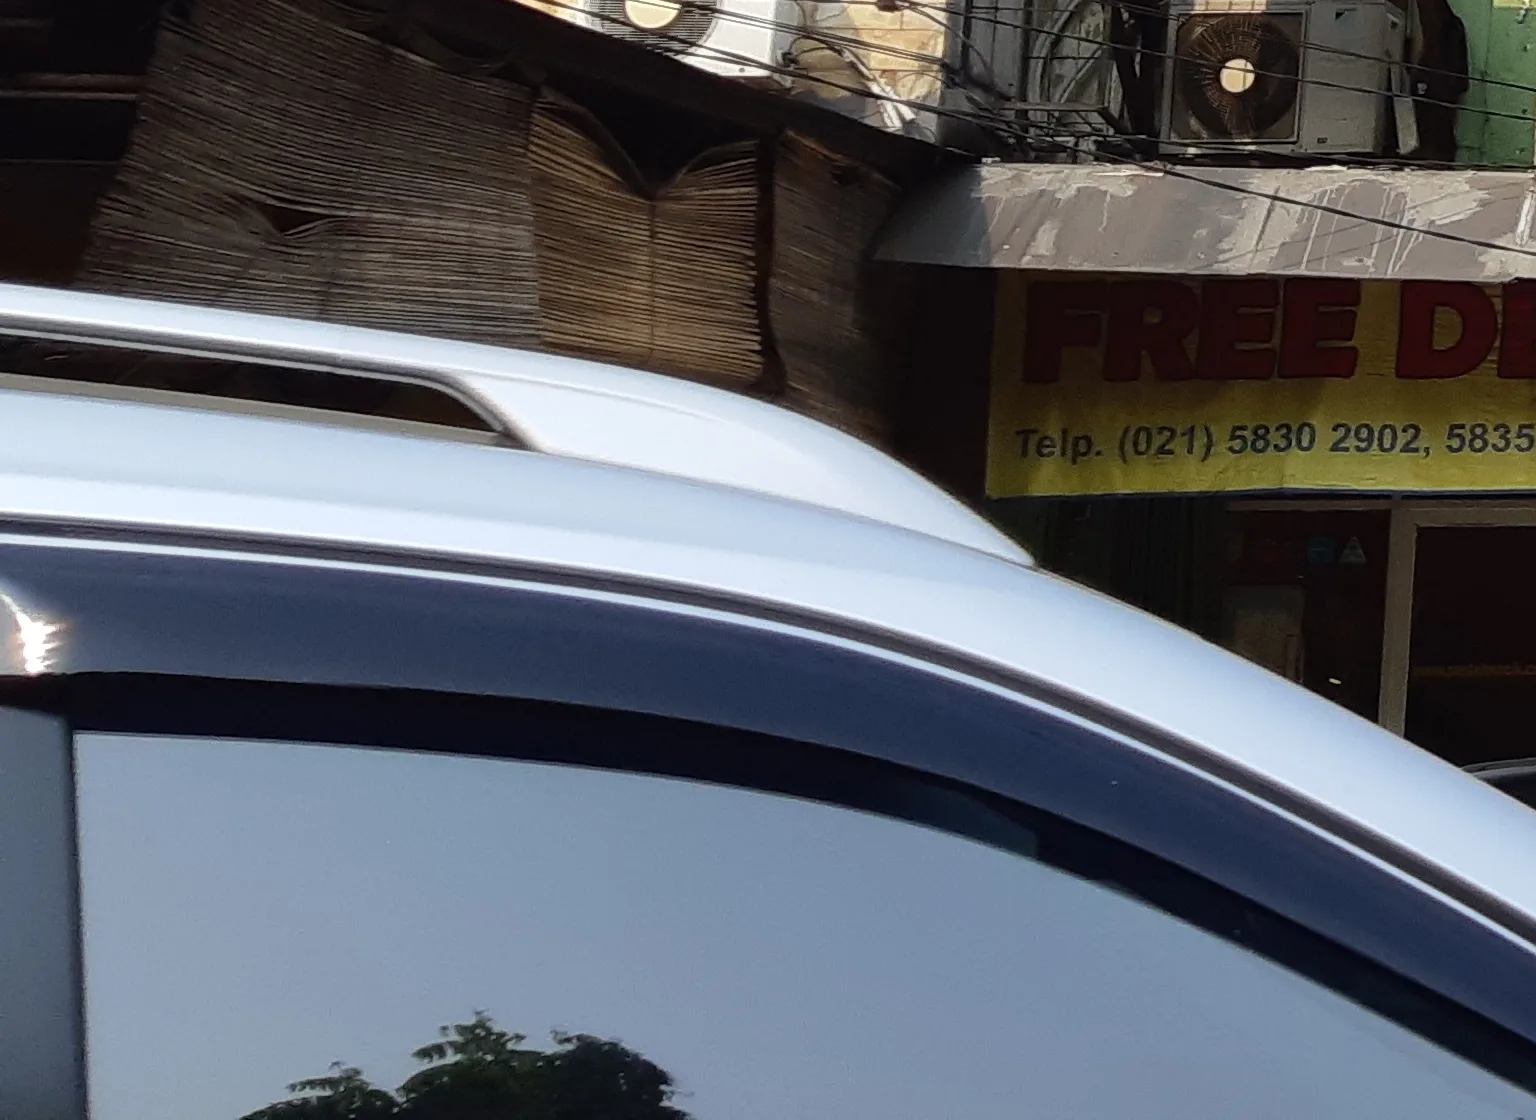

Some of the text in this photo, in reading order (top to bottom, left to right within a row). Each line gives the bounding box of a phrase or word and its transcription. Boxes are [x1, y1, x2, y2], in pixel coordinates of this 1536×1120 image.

[1022, 280, 1363, 384] FREE
[1014, 427, 1102, 466] Telp.
[1117, 424, 1215, 464] (021)
[1227, 422, 1317, 455] 5830
[1328, 421, 1431, 460] 2902,
[1444, 422, 1536, 454] 5835
